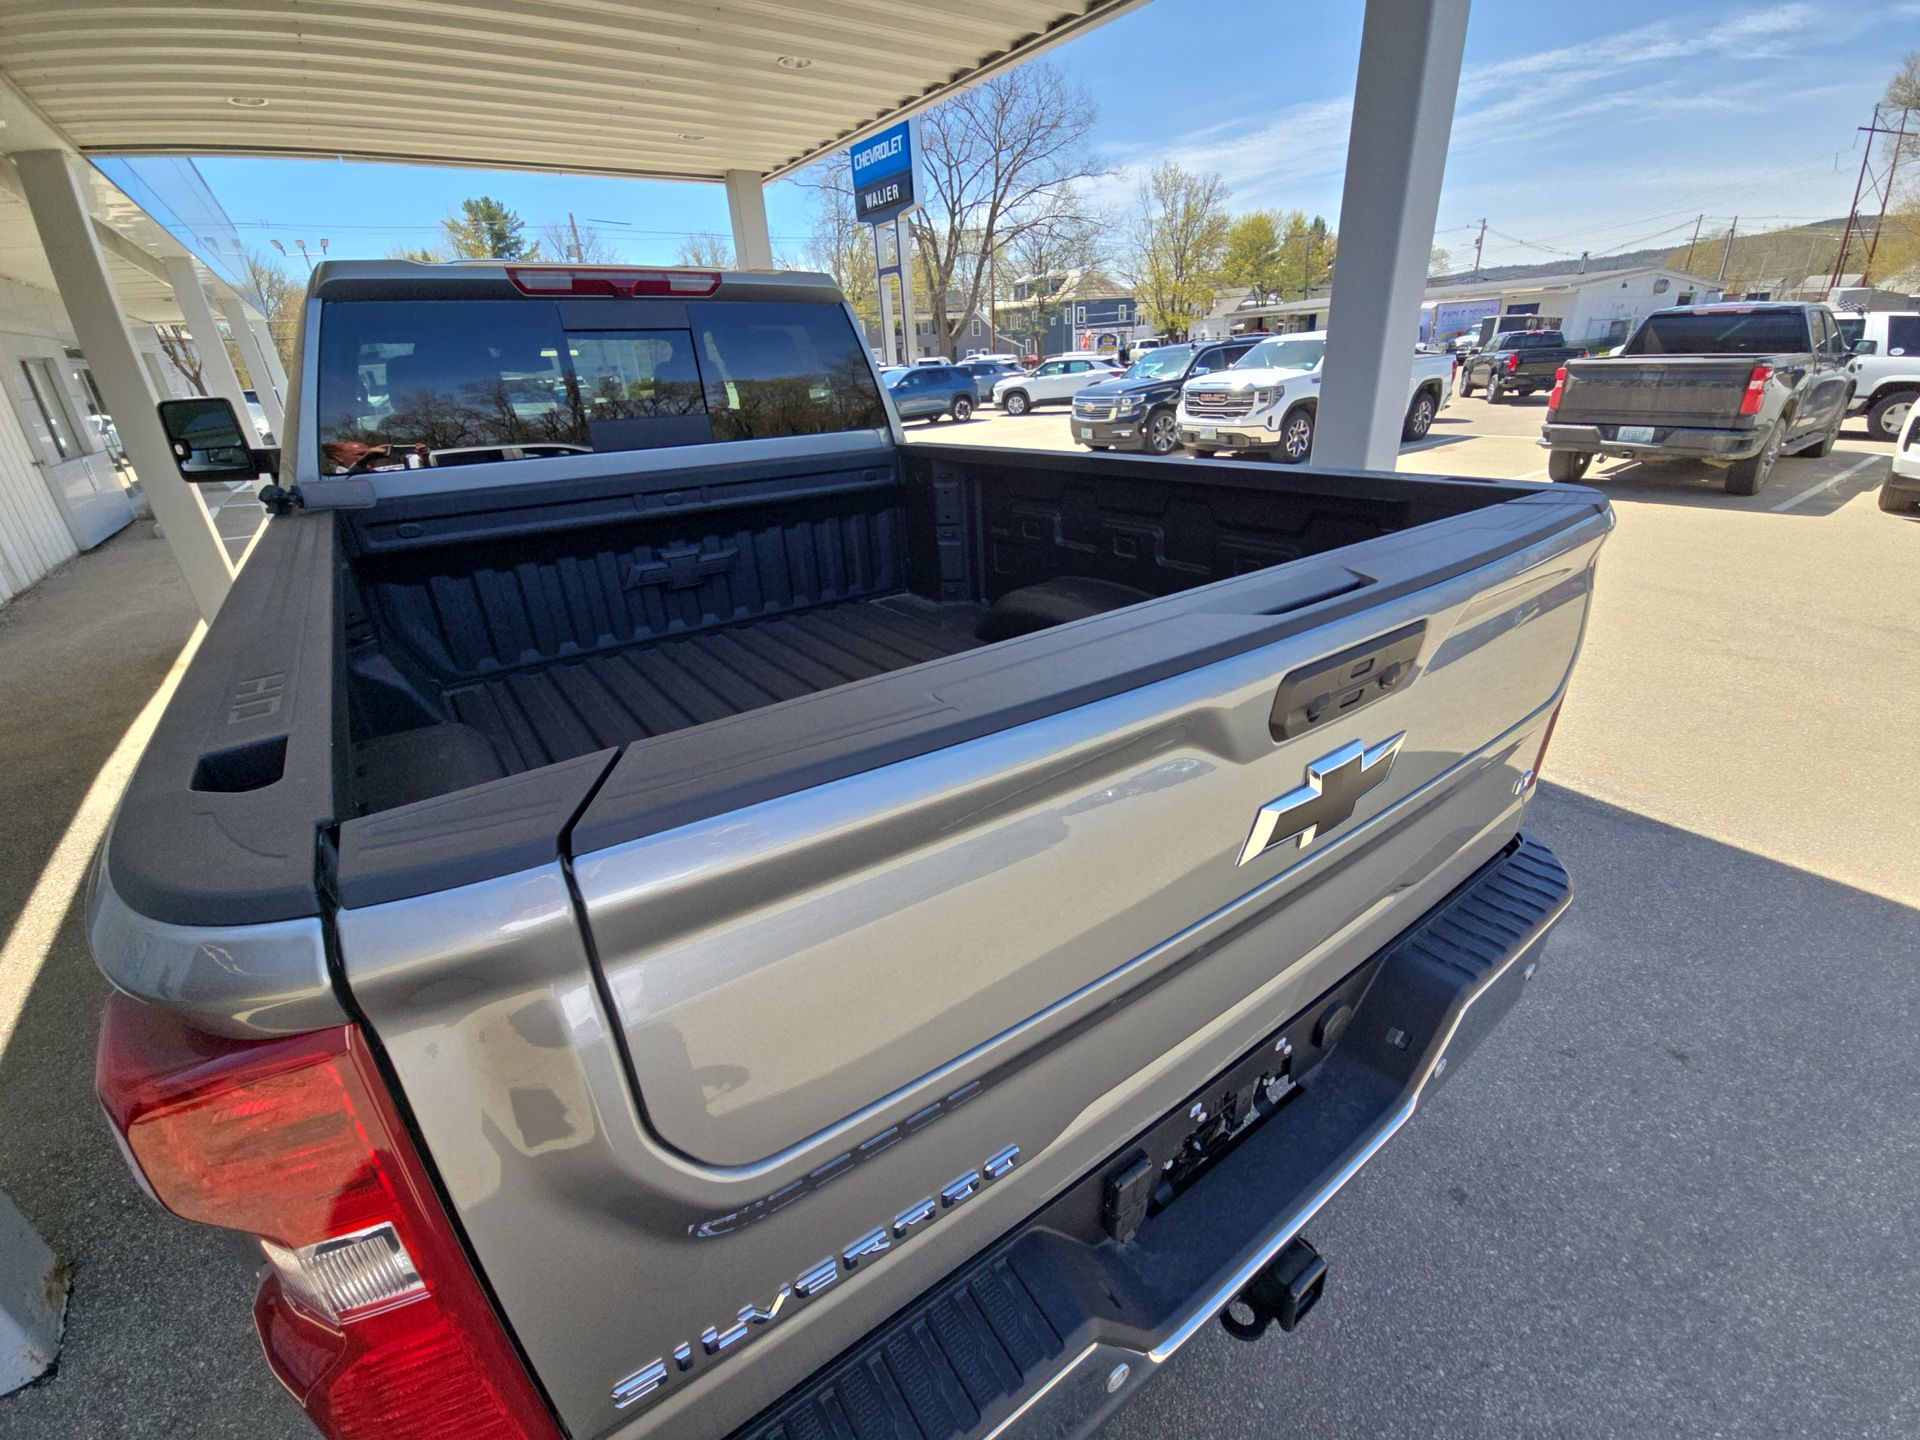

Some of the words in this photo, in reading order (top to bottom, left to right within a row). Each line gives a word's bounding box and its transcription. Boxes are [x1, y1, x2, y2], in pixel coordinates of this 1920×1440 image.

[854, 134, 903, 170] CHEVROLET
[865, 183, 899, 208] WALIER
[610, 1142, 1020, 1410] SILVERADO
